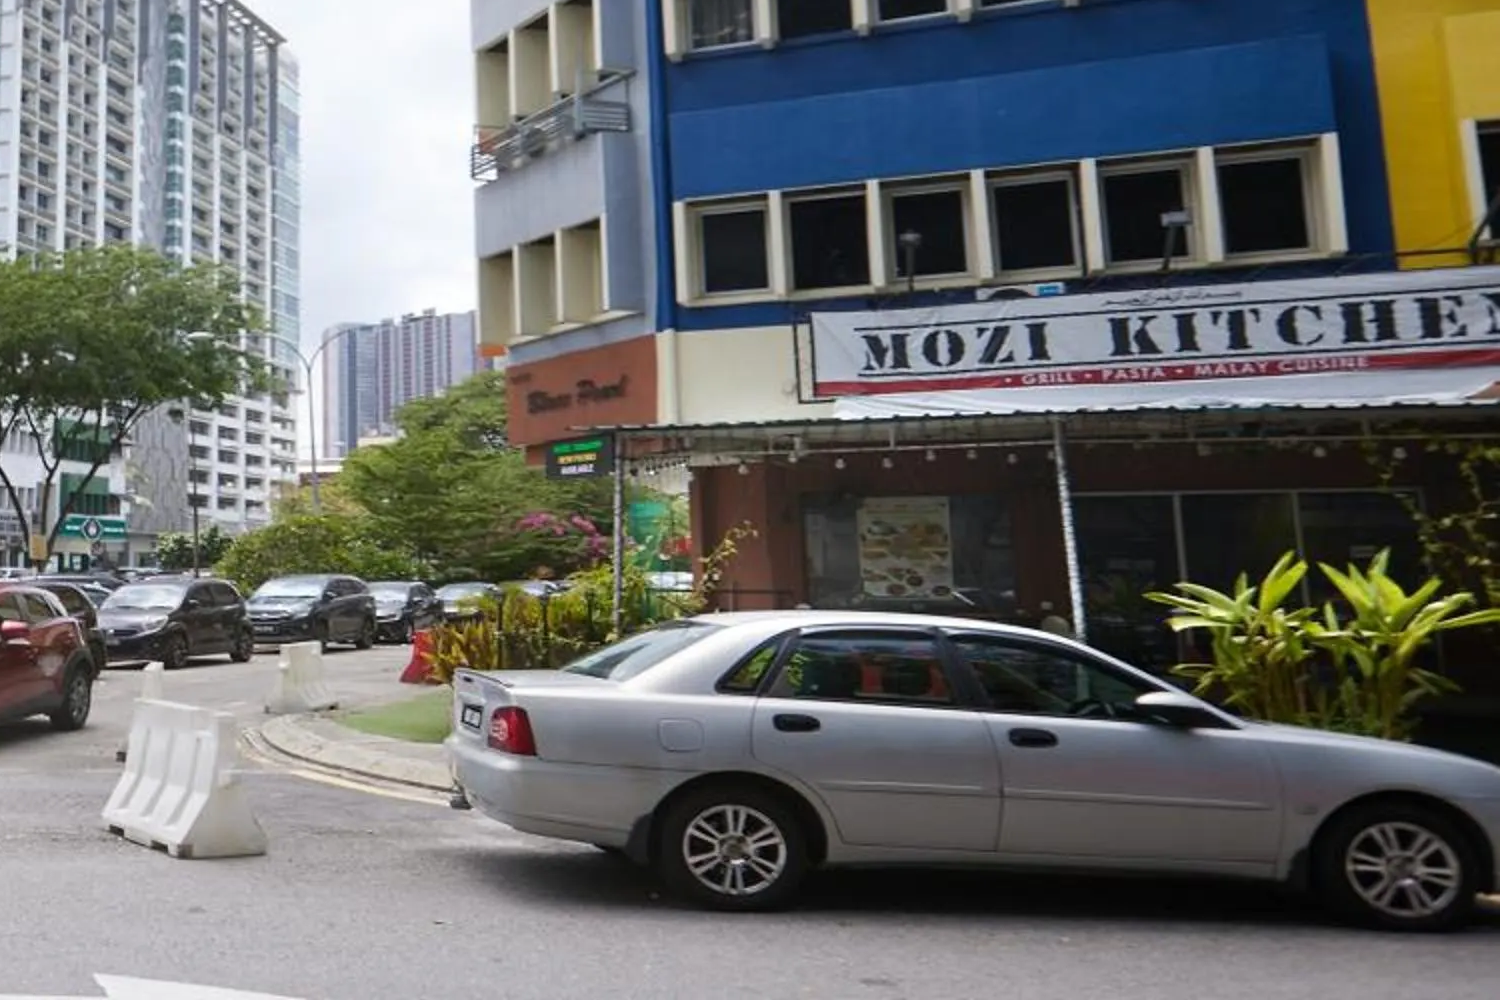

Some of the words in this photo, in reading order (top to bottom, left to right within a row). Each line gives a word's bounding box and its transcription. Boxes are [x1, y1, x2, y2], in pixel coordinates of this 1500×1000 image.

[860, 321, 1052, 371] MOZI
[1020, 372, 1076, 386] GRILL
[1101, 366, 1166, 381] PASTA
[1193, 361, 1269, 377] MALAY
[1277, 355, 1369, 372] CUISINE
